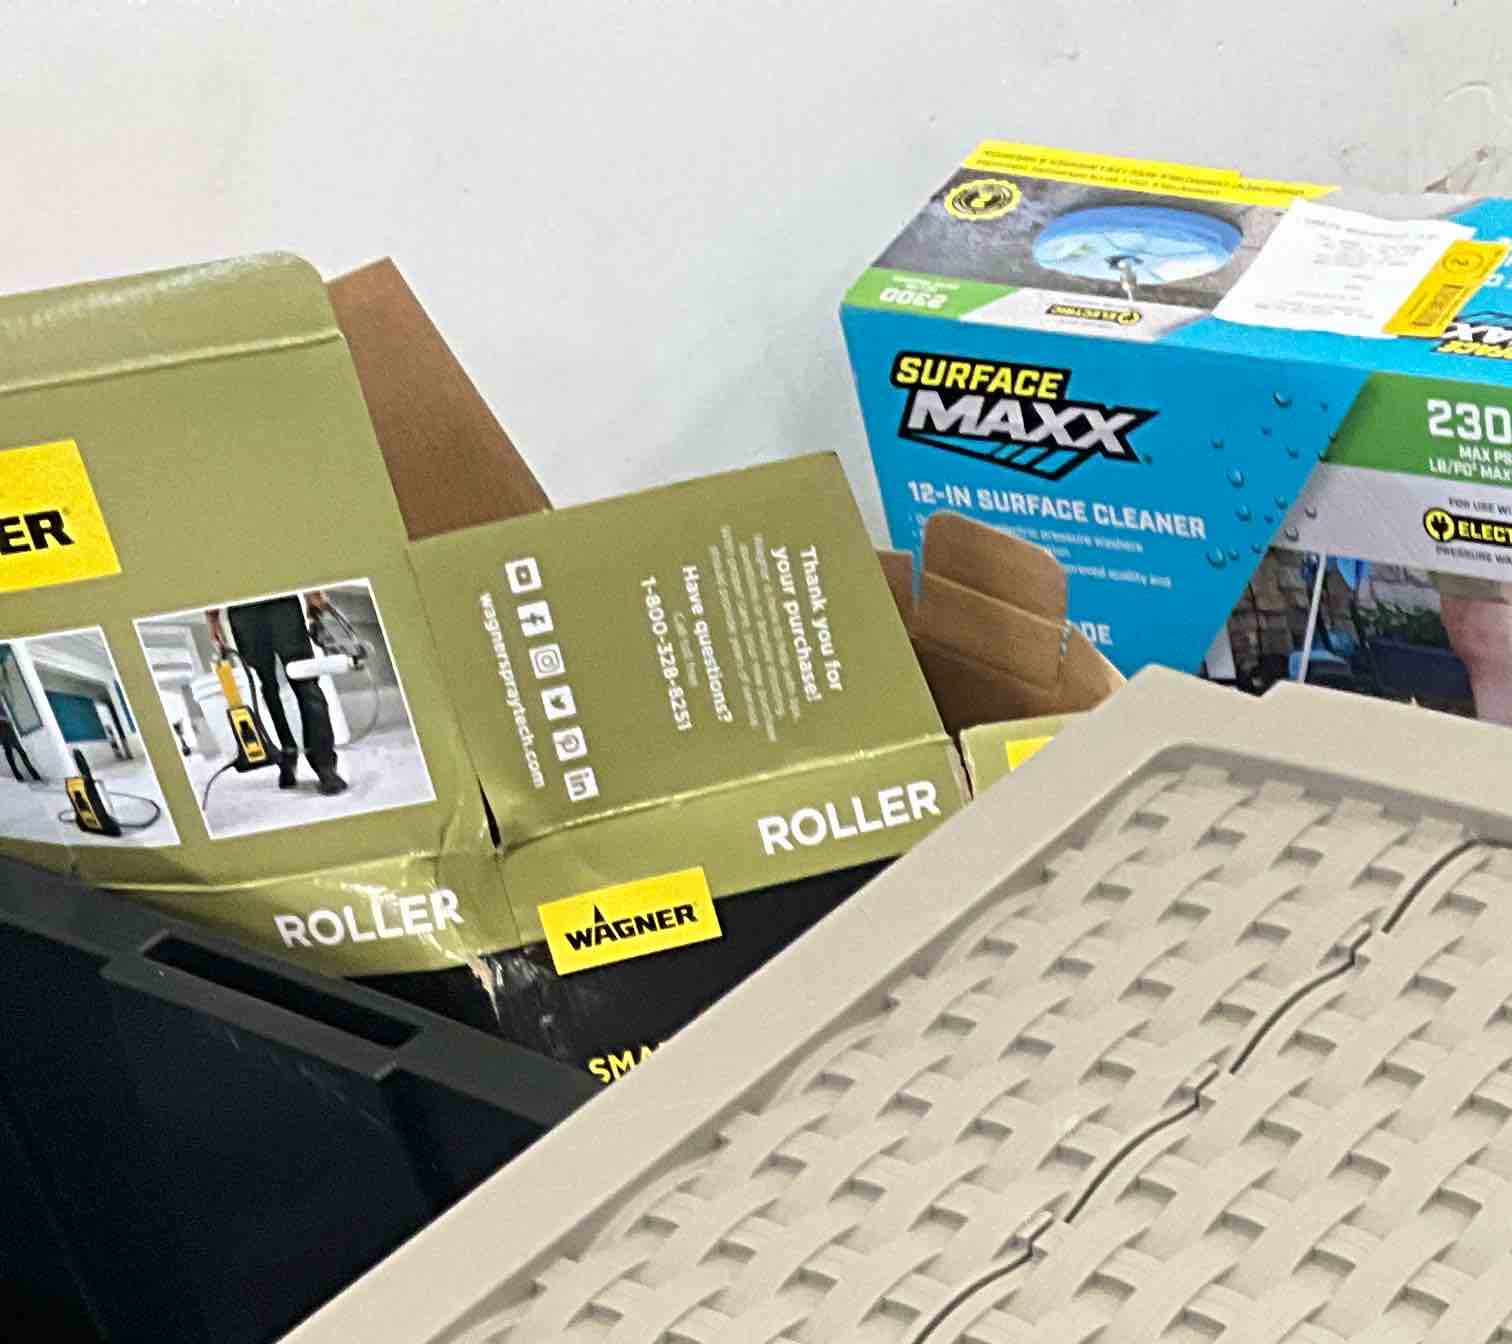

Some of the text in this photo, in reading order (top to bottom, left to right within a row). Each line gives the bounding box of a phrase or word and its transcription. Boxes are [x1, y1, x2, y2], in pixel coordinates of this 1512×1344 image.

[896, 355, 1064, 400] SURFACE
[907, 388, 1137, 455] MAXX
[1459, 445, 1491, 463] MAX
[907, 480, 1208, 540] 12-IN SURFACE CLEANER
[1448, 497, 1470, 511] FOR
[1473, 500, 1495, 514] USE
[771, 546, 796, 595] your
[1435, 544, 1492, 563] PRESSURE
[682, 565, 704, 616] Have
[694, 620, 734, 723] questions?
[800, 545, 844, 691] Thank you for
[641, 576, 693, 732] 1-800-328-8251
[782, 600, 823, 703] purchase!
[480, 592, 545, 789] wagnerspraytech.com
[757, 780, 942, 856] ROLLER
[273, 888, 465, 949] ROLLER
[564, 903, 699, 951] WAGNER
